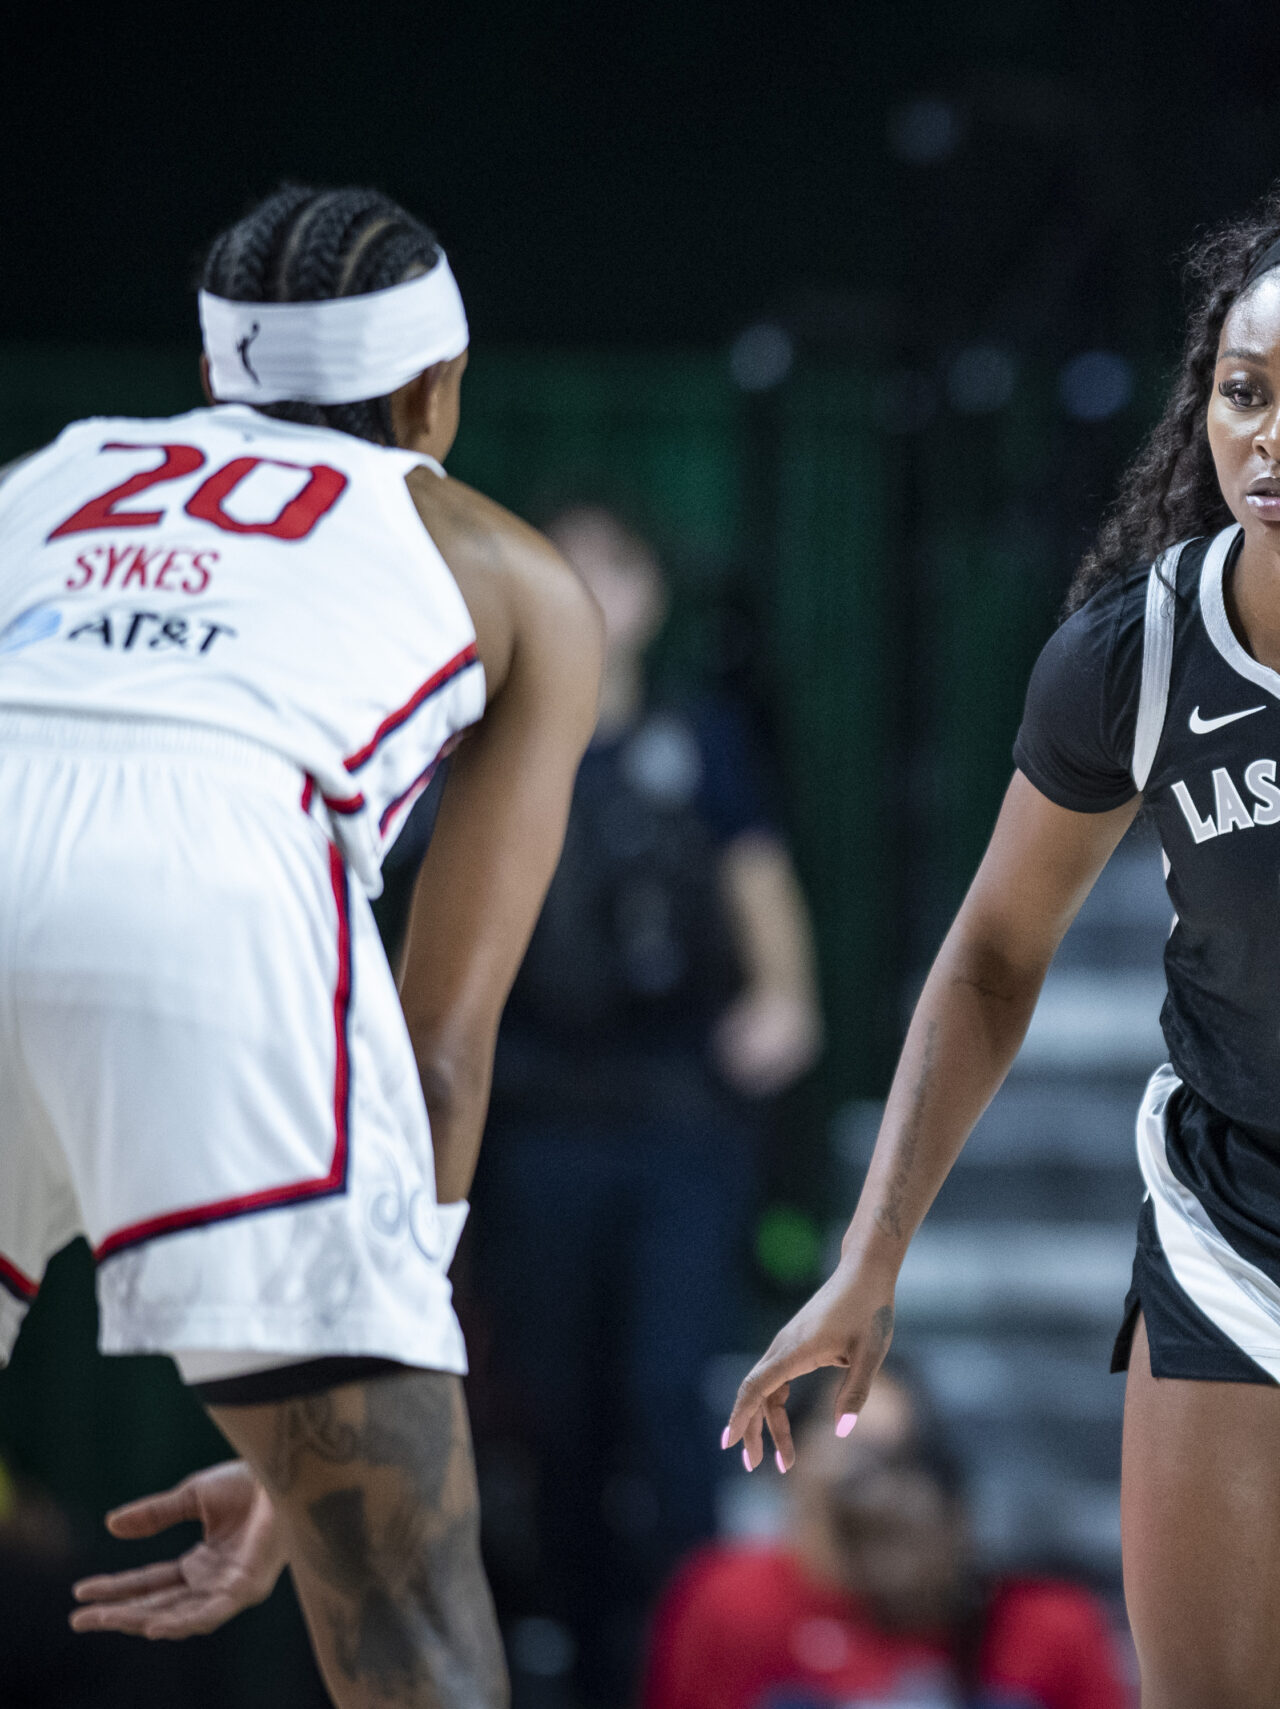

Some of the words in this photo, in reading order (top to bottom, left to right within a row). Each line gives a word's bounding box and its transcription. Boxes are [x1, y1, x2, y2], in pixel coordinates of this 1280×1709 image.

[46, 443, 349, 542] 20
[66, 545, 220, 594] SYKES
[67, 611, 237, 655] AT&T
